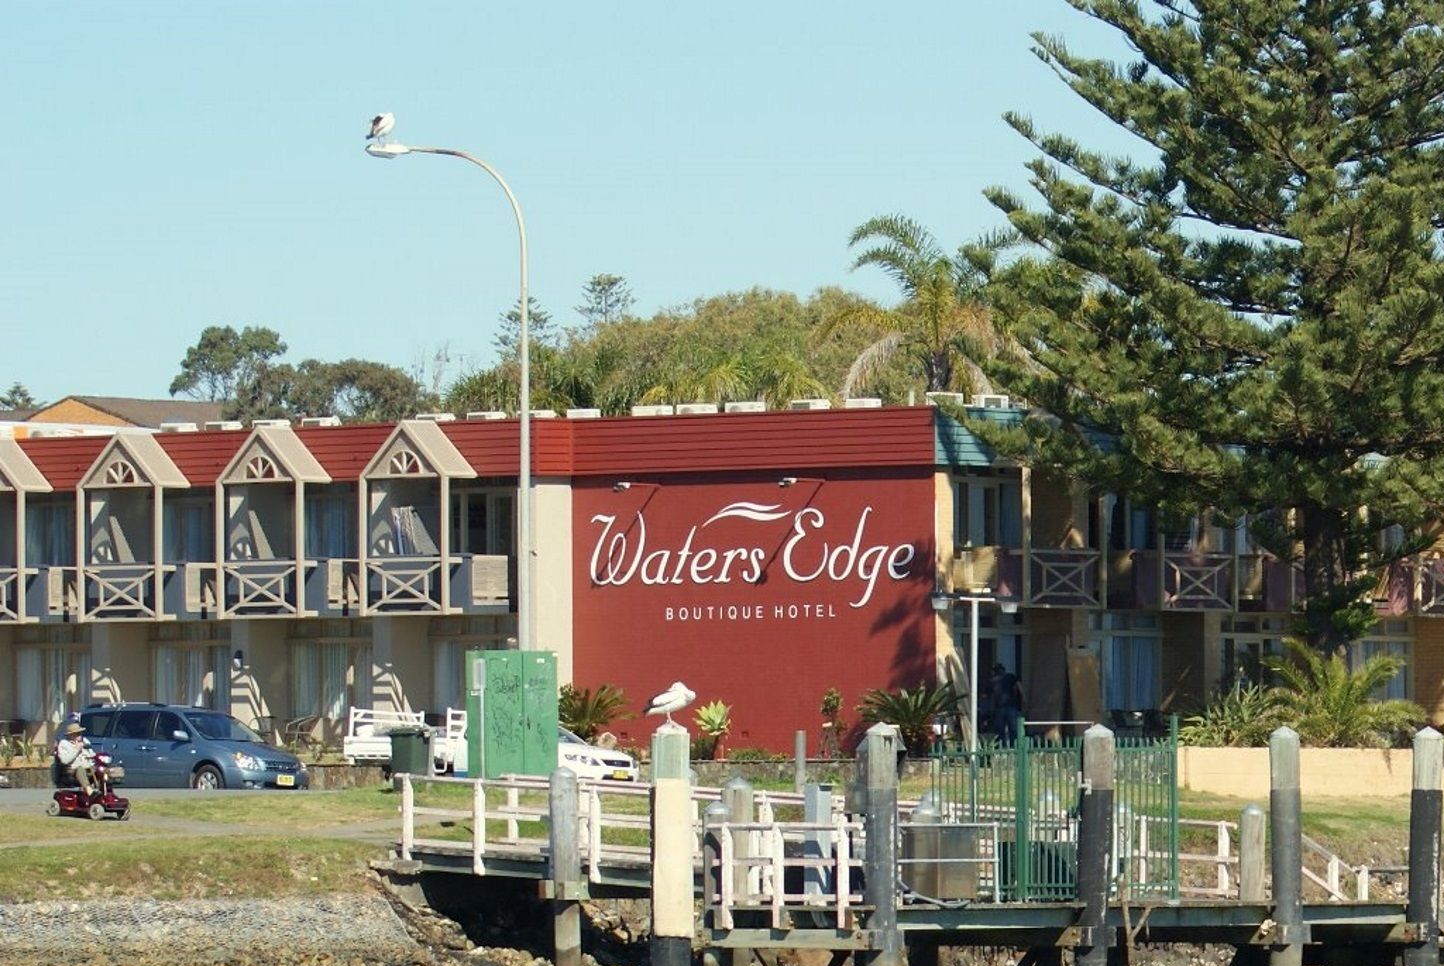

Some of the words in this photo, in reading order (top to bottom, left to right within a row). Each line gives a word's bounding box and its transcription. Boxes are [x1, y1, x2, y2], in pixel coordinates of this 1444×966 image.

[589, 510, 765, 586] Waters
[783, 506, 915, 608] Edge
[665, 605, 765, 621] BOUTIQUE
[774, 604, 836, 619] HOTEL
